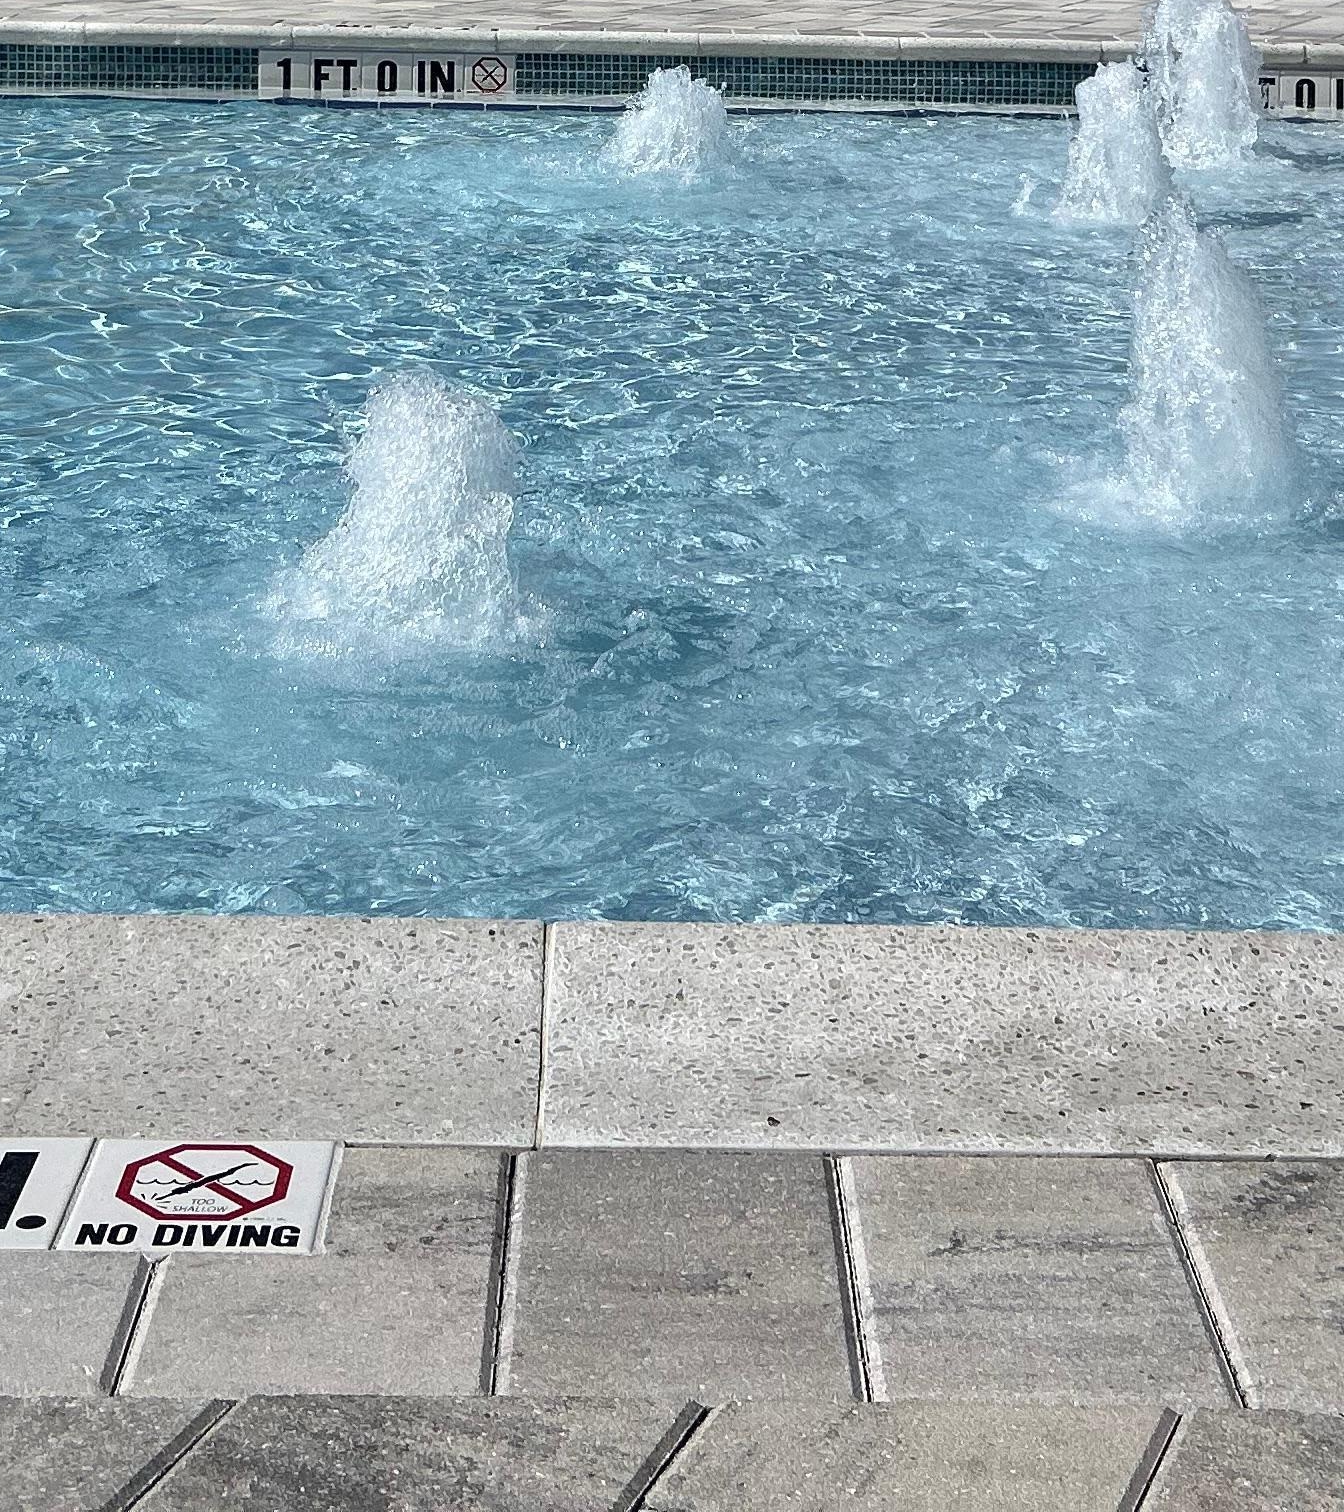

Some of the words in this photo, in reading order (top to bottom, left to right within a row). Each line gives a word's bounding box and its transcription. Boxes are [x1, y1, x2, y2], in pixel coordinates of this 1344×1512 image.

[276, 57, 292, 90] 1
[172, 1205, 228, 1213] SHALLOW
[191, 1198, 216, 1206] TOO
[74, 1223, 138, 1246] NO
[151, 1223, 301, 1248] DIVING
